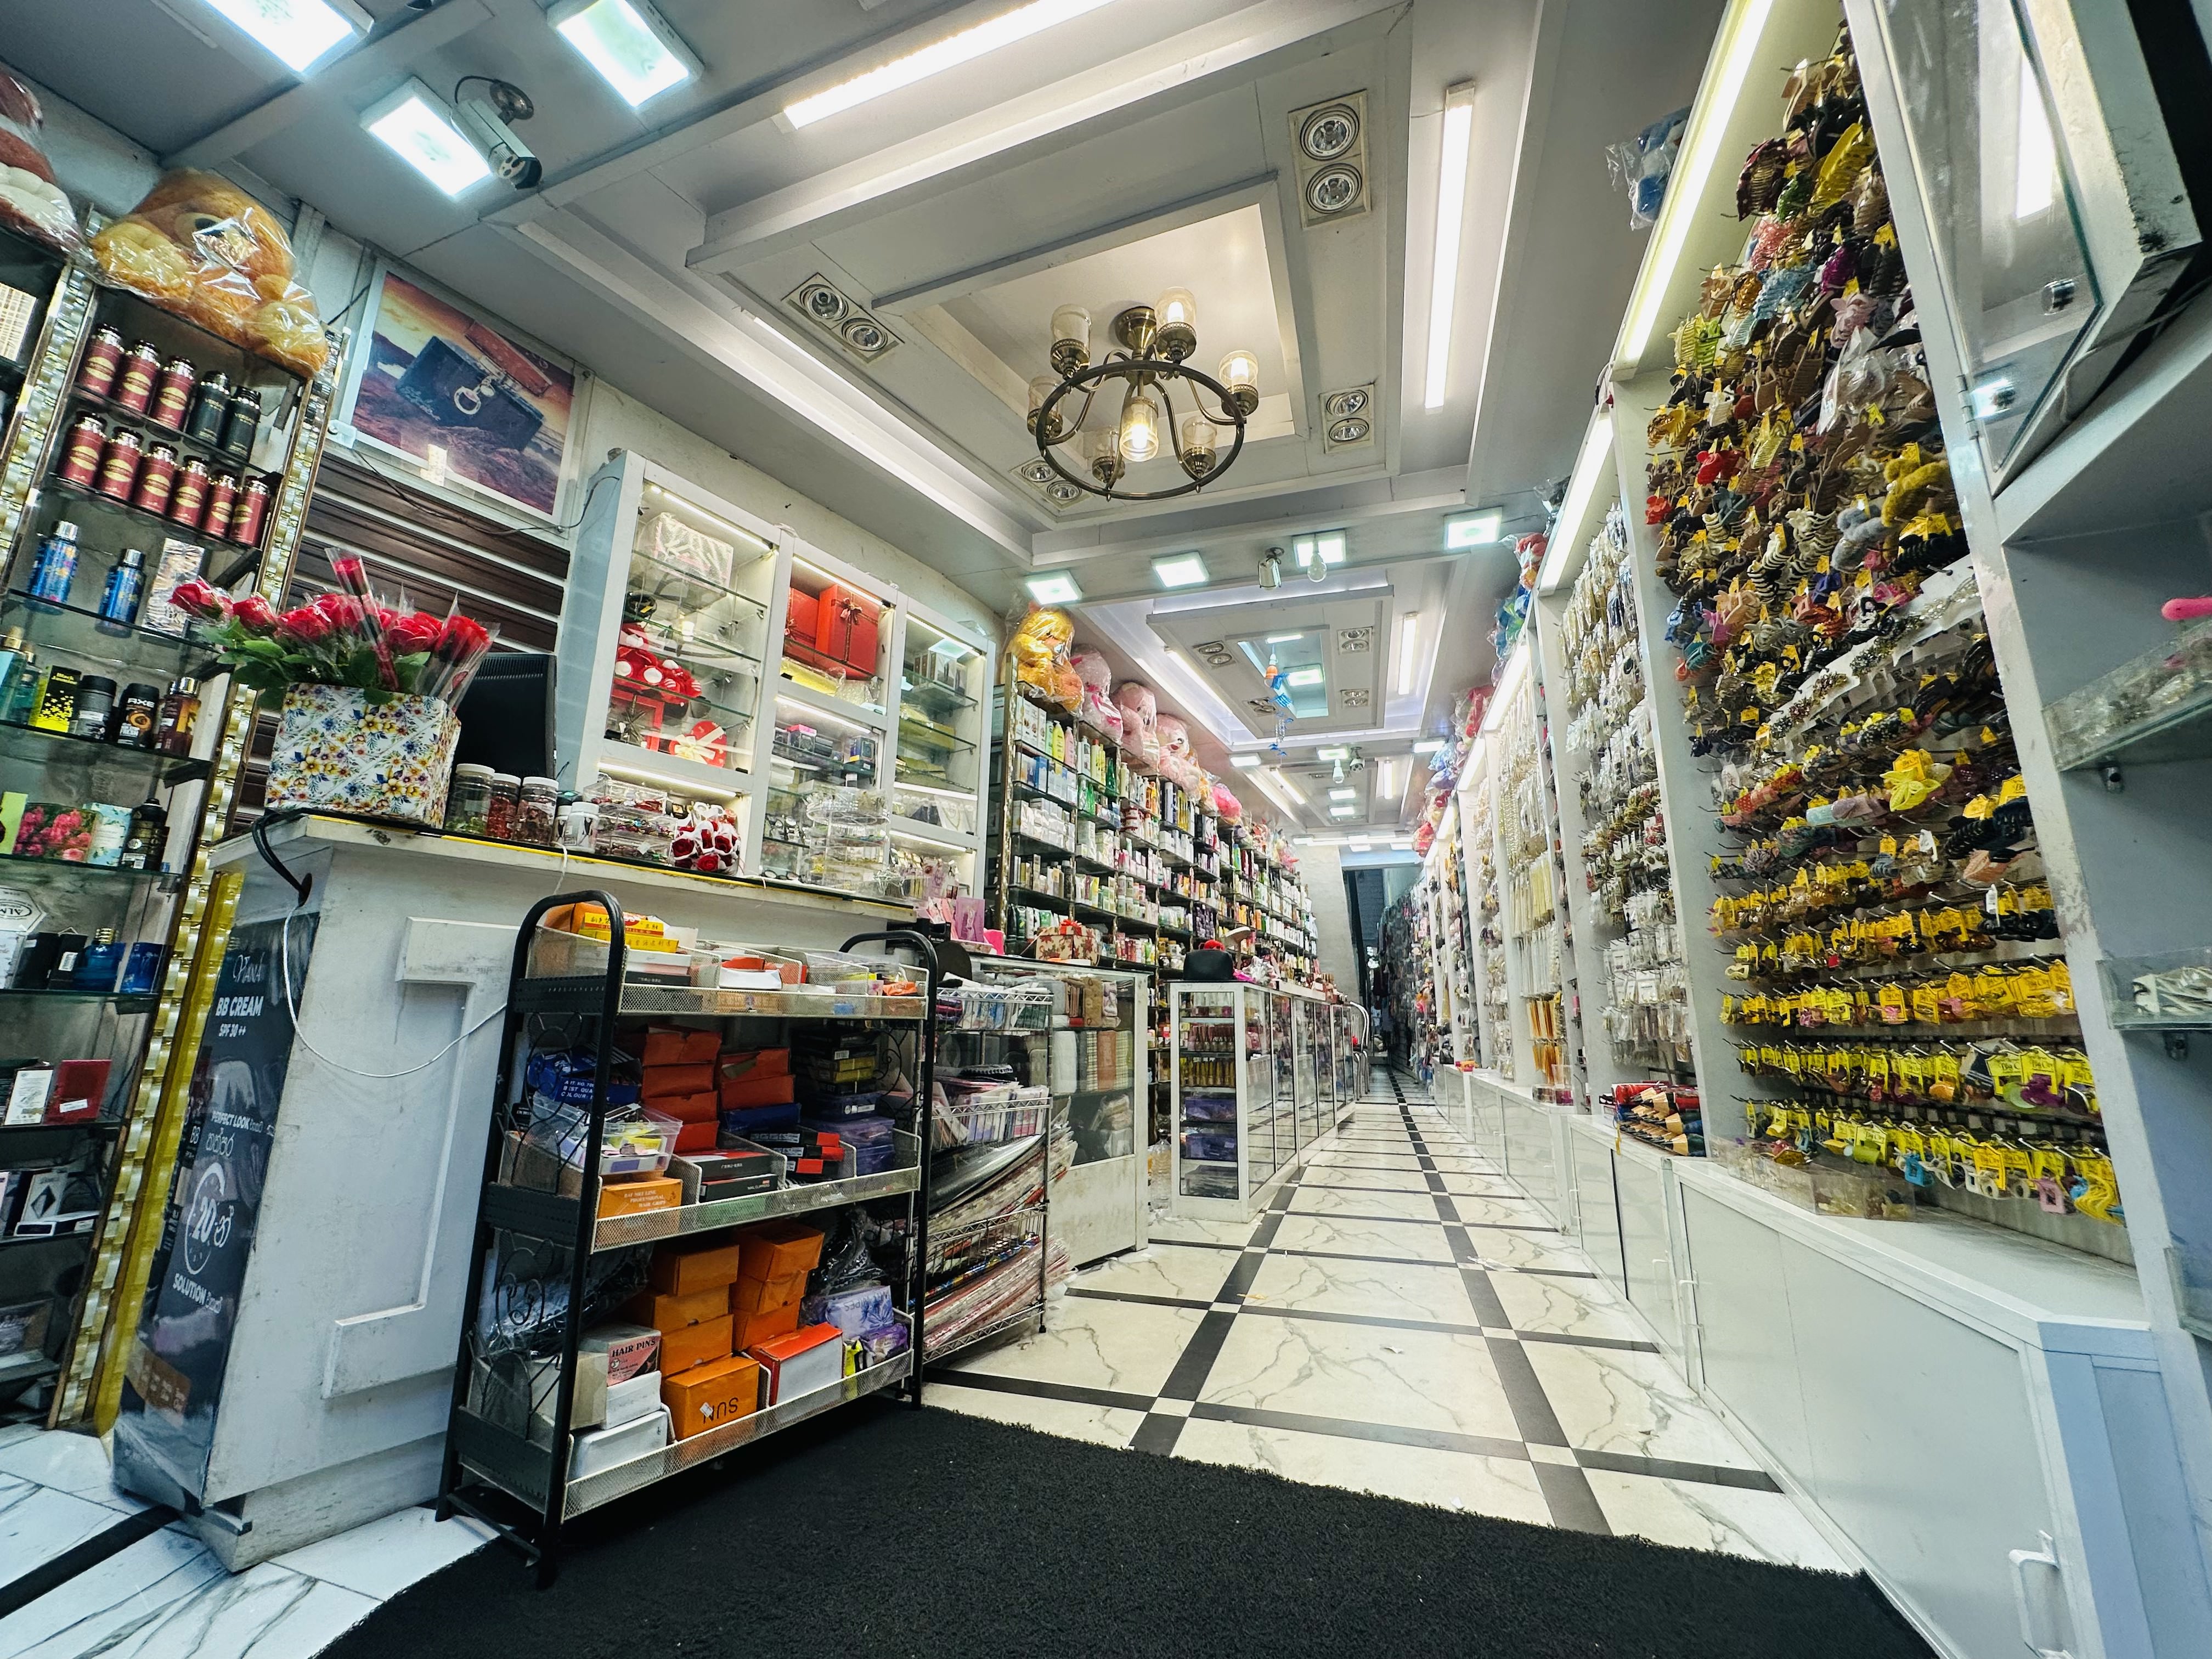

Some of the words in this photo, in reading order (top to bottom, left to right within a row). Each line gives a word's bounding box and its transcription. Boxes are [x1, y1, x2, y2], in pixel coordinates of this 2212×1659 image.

[127, 697, 155, 708] AXE
[216, 996, 230, 1017] BB
[229, 996, 264, 1017] CREAM
[218, 1023, 230, 1037] SPF
[229, 1024, 239, 1037] 30
[211, 1110, 235, 1126] PERFECT
[232, 1114, 251, 1130] LOOK
[191, 1196, 217, 1243] 20
[172, 1273, 207, 1306] SOLUTION
[612, 1345, 634, 1357] HAIR
[636, 1339, 656, 1351] PINS
